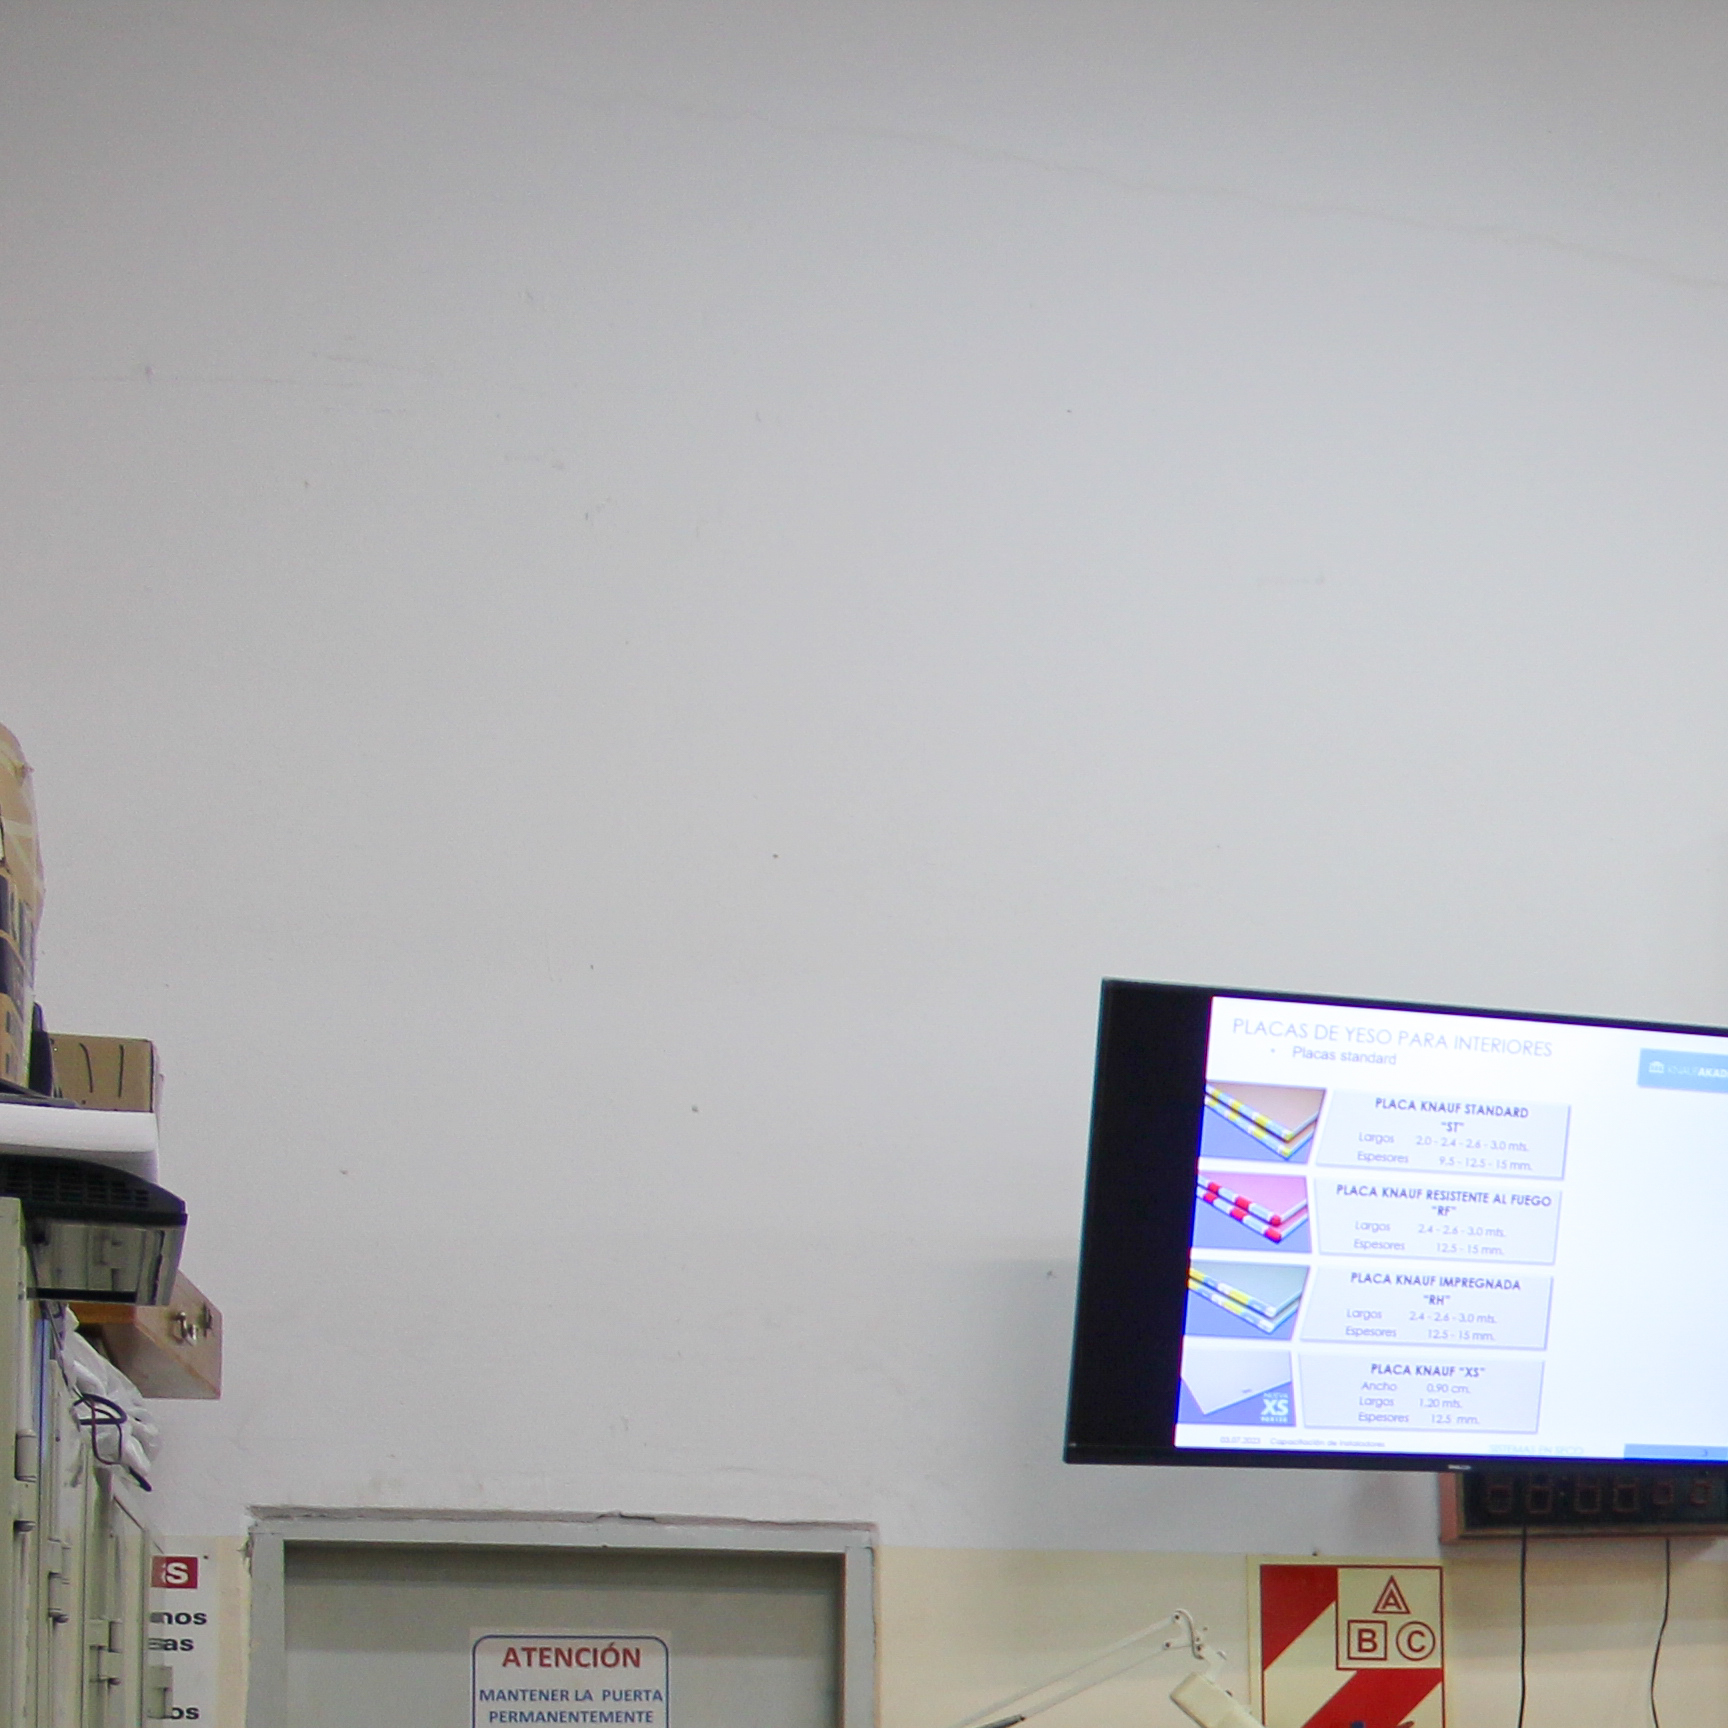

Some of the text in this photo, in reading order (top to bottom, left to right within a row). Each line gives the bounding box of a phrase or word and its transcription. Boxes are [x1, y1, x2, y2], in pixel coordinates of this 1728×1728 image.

[1232, 1018, 1554, 1058] PLACAS DE YESO PARA INTERIORES
[1292, 1046, 1398, 1066] Placas standard
[1375, 1097, 1529, 1119] PLACA KNAUF STANDARD
[1358, 1132, 1395, 1145] Largos
[1357, 1151, 1409, 1165] Espesores
[1336, 1184, 1553, 1208] PLACA KNAUF RESISTENTE AL FUEGO
[1355, 1221, 1391, 1233] Largos
[1353, 1238, 1406, 1252] Espesores
[1350, 1272, 1521, 1291] PLACA KNAUF IMPREGNADA
[1346, 1308, 1382, 1321] Largos
[1345, 1325, 1397, 1339] Espesores
[1371, 1363, 1412, 1376] PLACA
[1415, 1364, 1456, 1377] KNAUF
[1360, 1381, 1398, 1392] Ancho
[1260, 1398, 1289, 1416] XS
[1359, 1396, 1395, 1408] Largos
[1357, 1412, 1409, 1425] Espesores
[1357, 1628, 1426, 1653] B C
[502, 1641, 642, 1669] ATENCIÓN
[479, 1688, 663, 1702] MANTENER LA PUERTA
[489, 1709, 654, 1724] PERMANENTEMENTE
